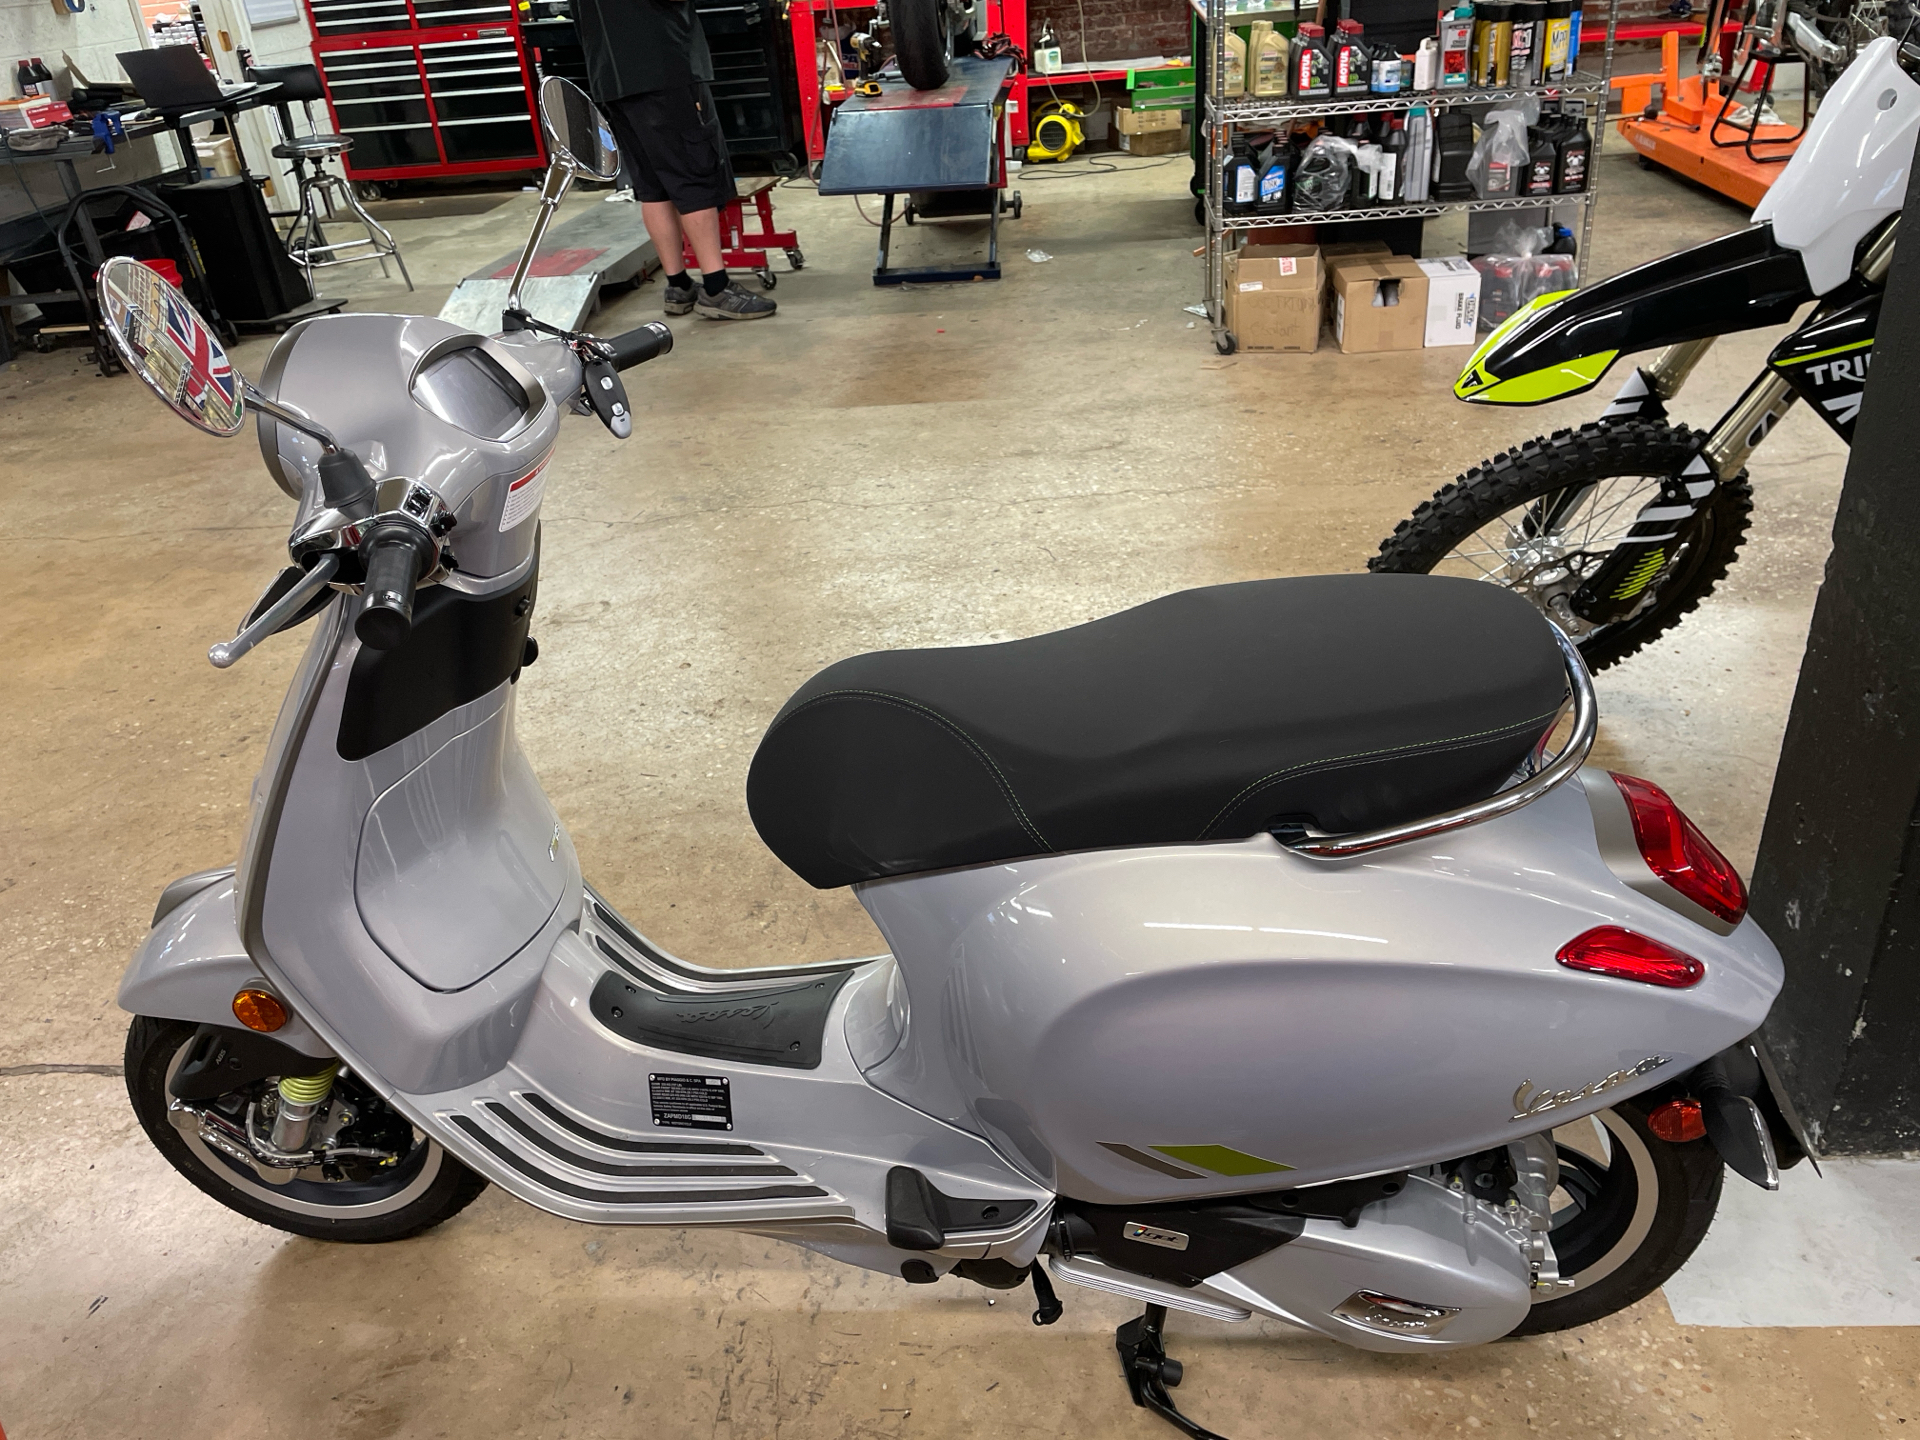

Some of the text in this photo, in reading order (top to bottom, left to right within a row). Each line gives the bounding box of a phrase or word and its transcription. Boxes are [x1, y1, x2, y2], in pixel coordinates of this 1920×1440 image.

[1301, 54, 1311, 88] MOTUL
[1340, 50, 1350, 84] MOTUL
[1455, 292, 1465, 330] BRAKE FLUID
[676, 1001, 779, 1029] Vespa
[216, 1049, 226, 1065] ABS
[1508, 1053, 1674, 1124] Vespa
